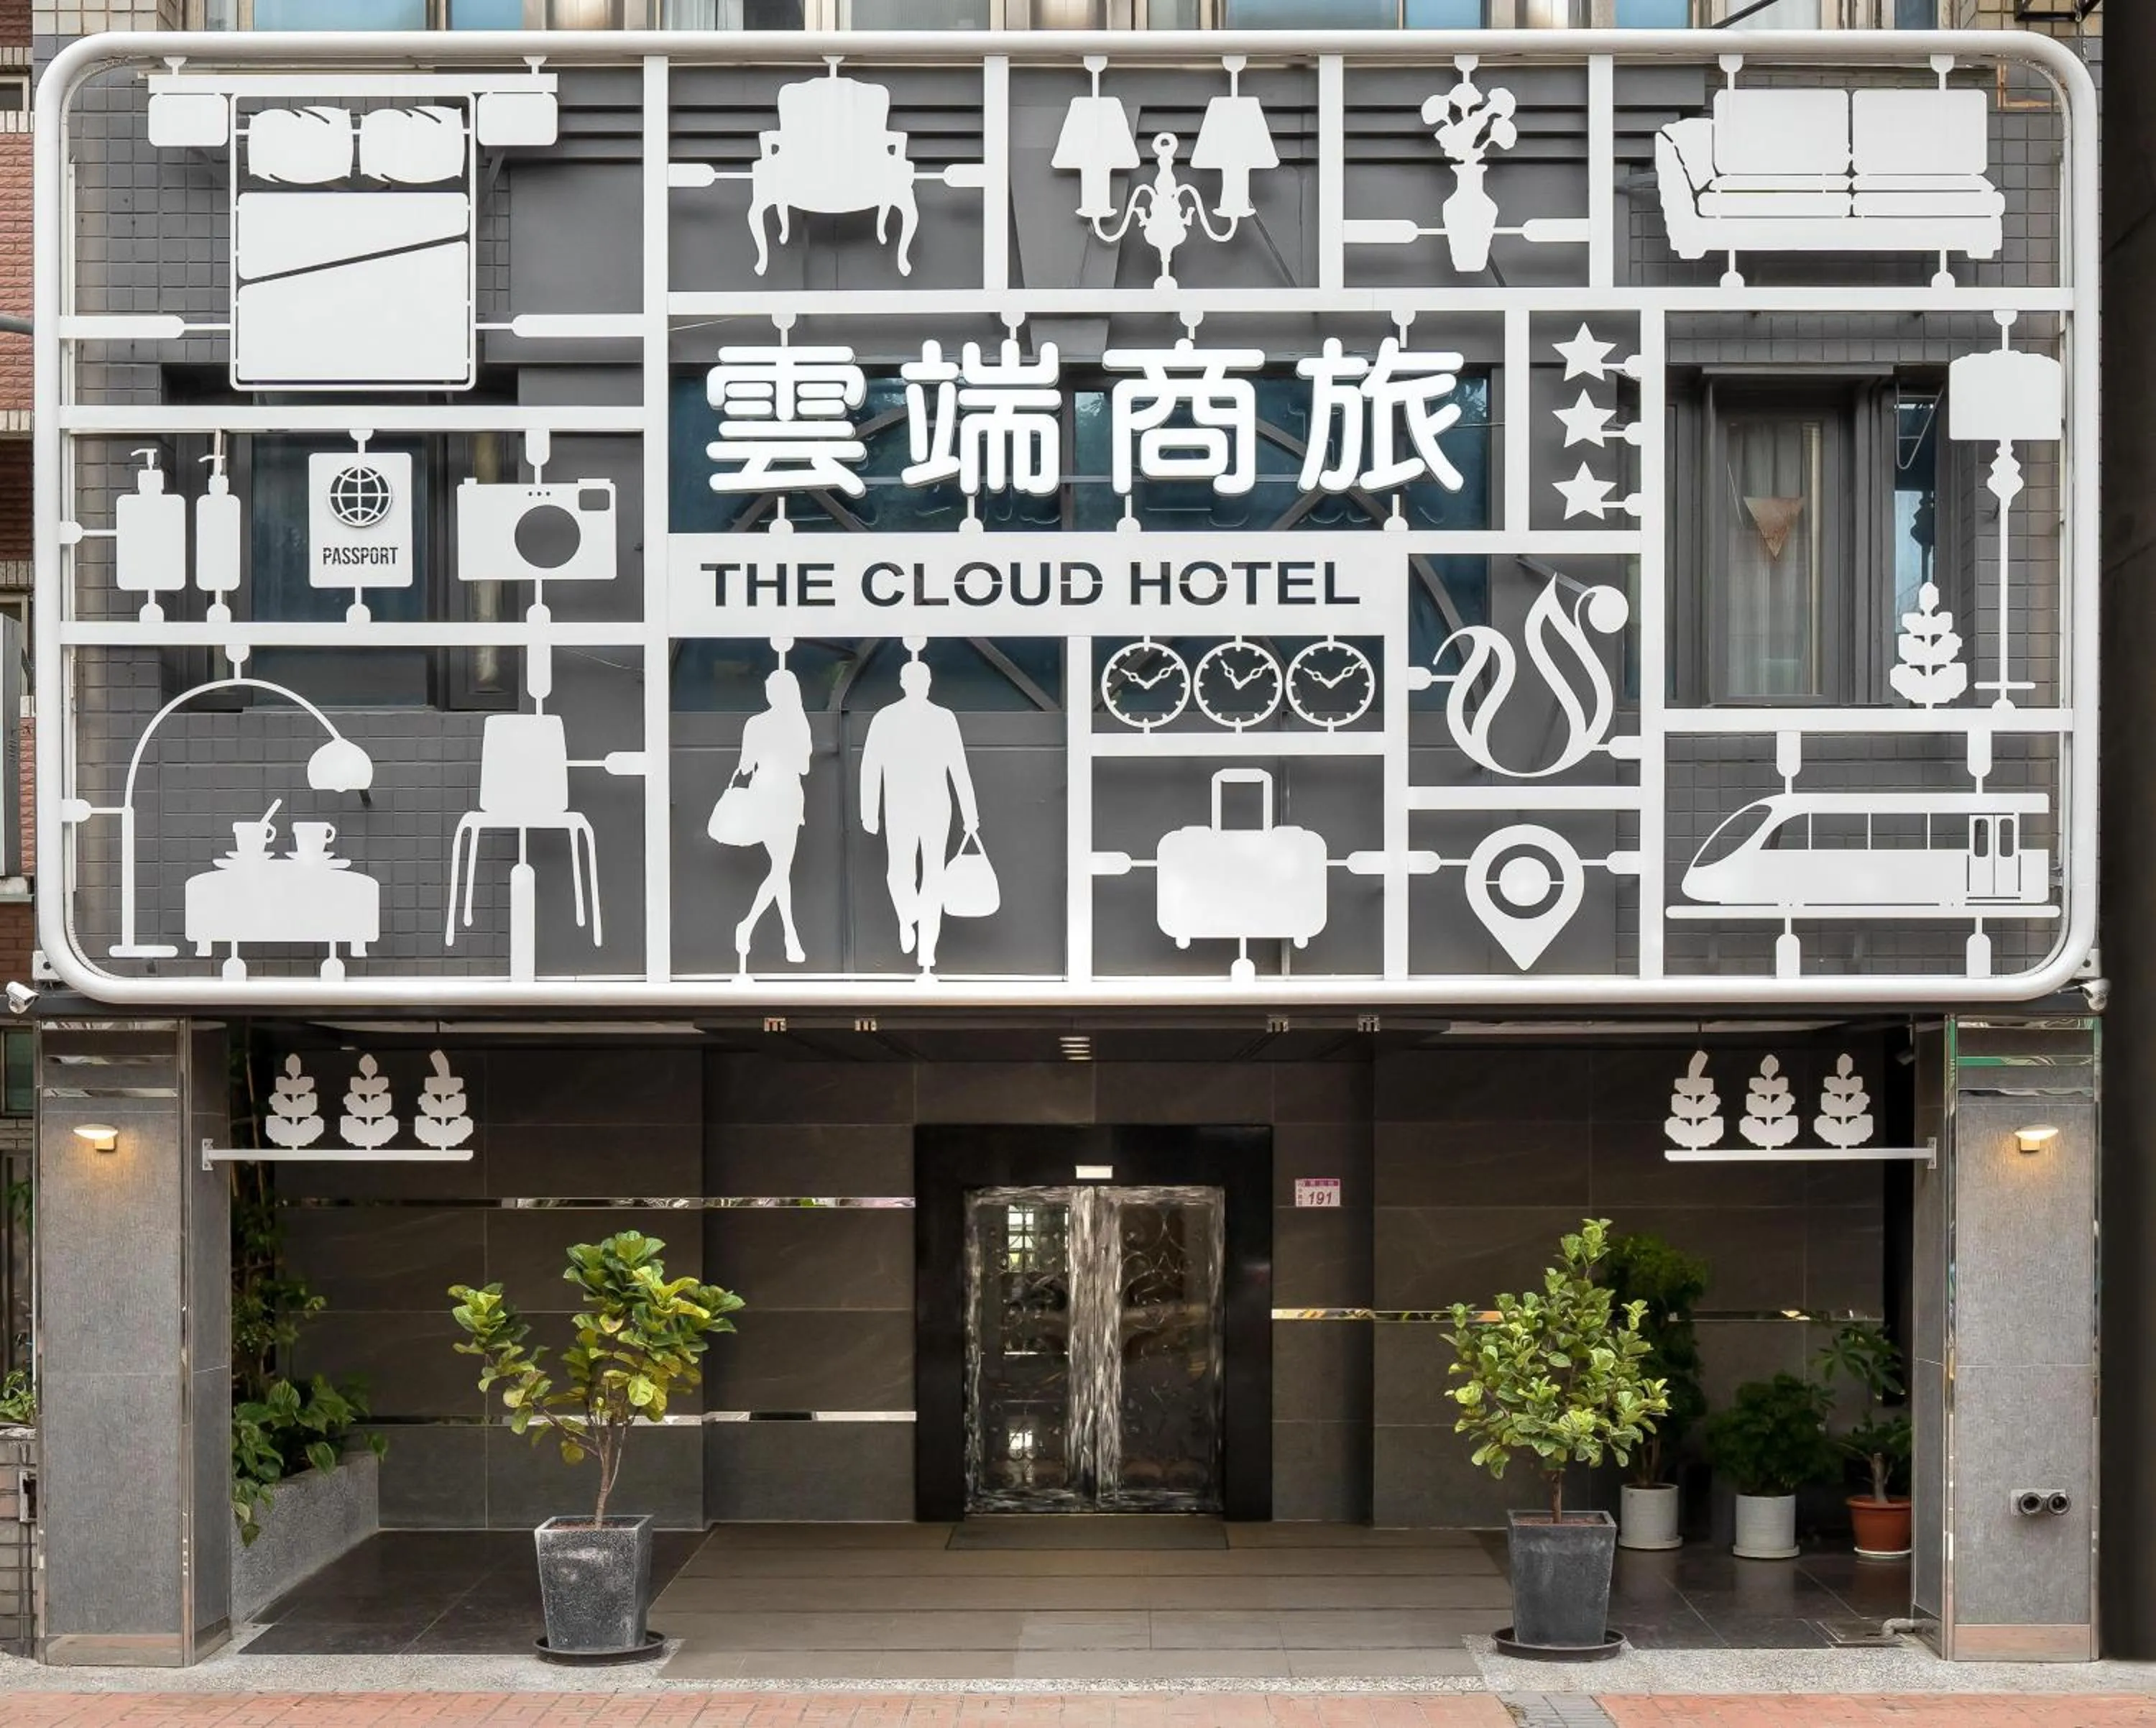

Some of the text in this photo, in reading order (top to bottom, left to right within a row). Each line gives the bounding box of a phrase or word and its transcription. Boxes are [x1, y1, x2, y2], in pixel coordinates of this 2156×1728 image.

[706, 336, 1465, 497] 雲端商旅
[323, 547, 399, 565] PASSPORT
[700, 561, 1360, 607] THE CLOUD HOTEL
[1309, 1191, 1332, 1205] 191
